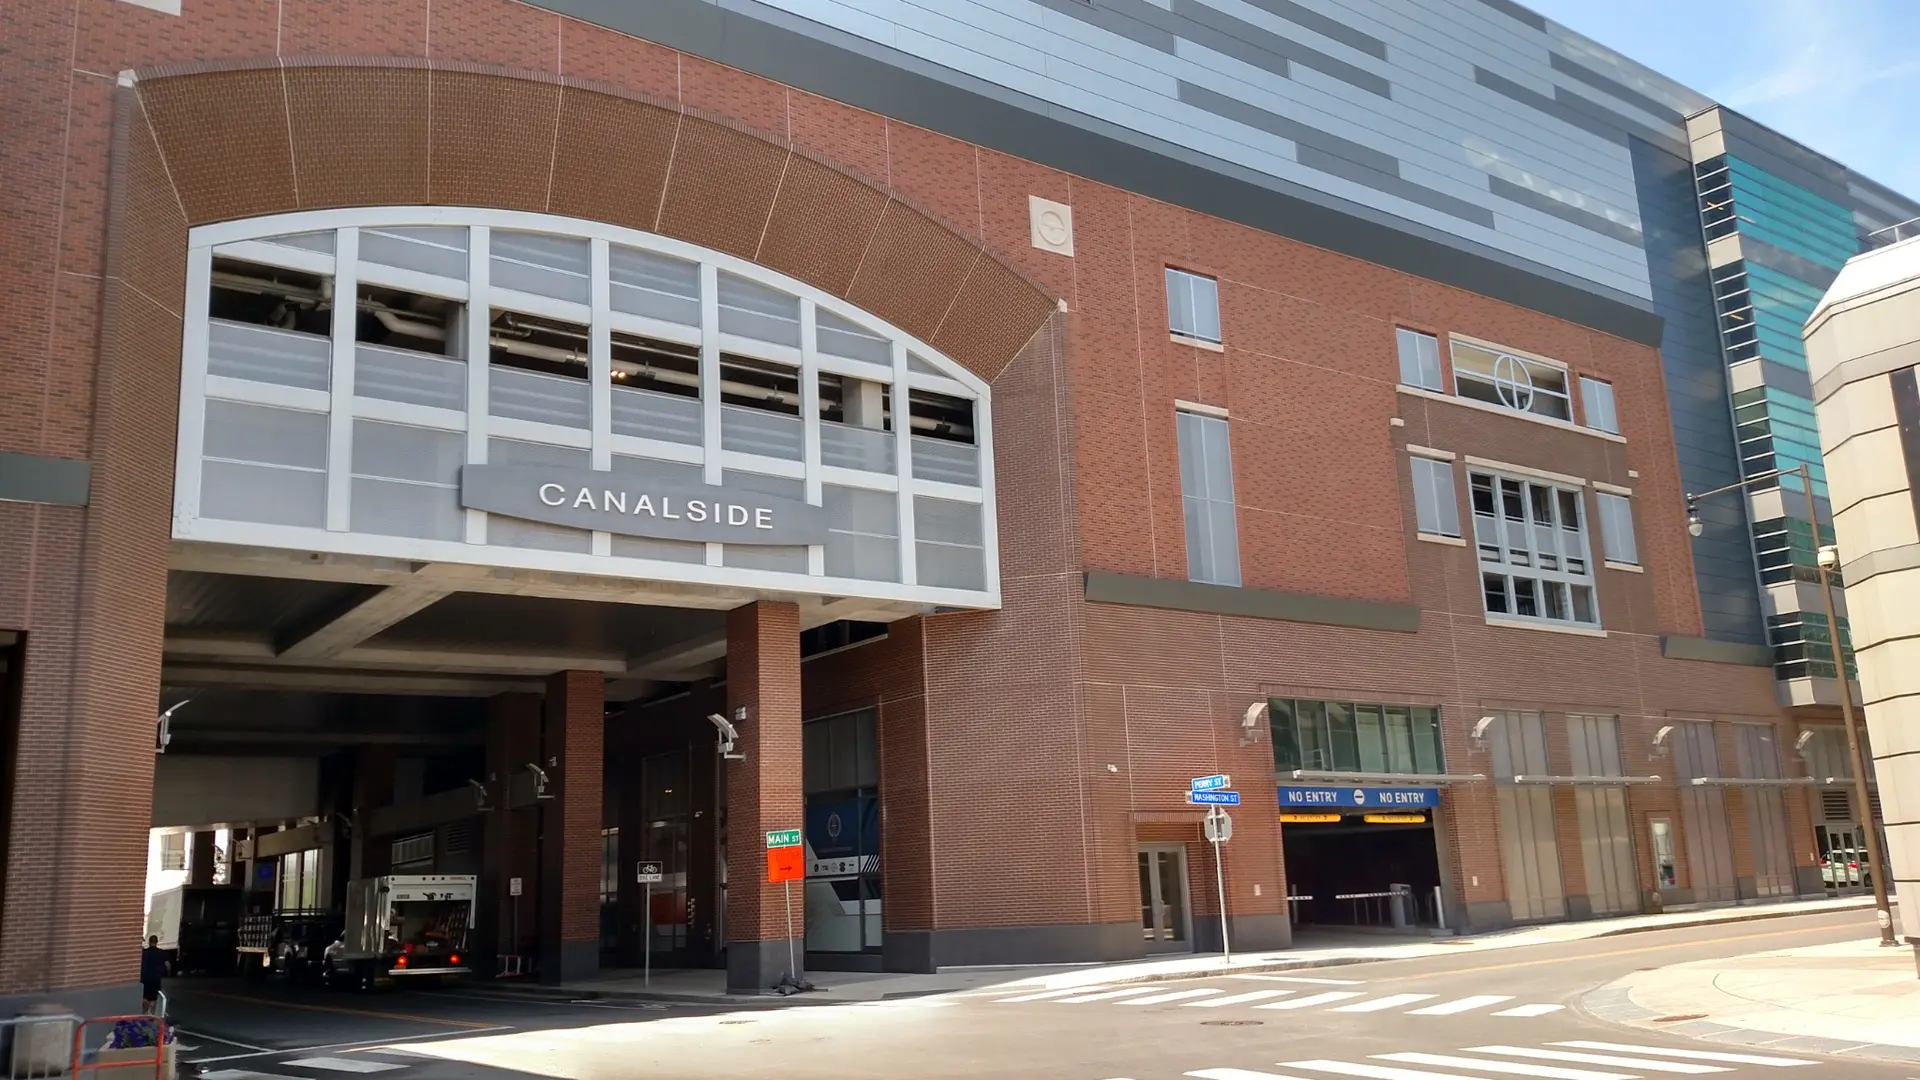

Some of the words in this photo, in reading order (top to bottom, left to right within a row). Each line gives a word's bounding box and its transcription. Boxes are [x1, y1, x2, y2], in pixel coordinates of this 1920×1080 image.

[538, 482, 774, 530] CANALSIDE
[1194, 779, 1213, 789] PERRY
[1213, 776, 1222, 786] ST
[1194, 793, 1229, 802] WASHINGTON
[1229, 794, 1238, 803] ST
[1288, 791, 1303, 803] NO
[1305, 791, 1338, 803] ENTRY
[1379, 792, 1393, 803] NO
[1395, 792, 1425, 804] ENTRY
[768, 833, 790, 845] MAIN
[791, 834, 799, 843] ST
